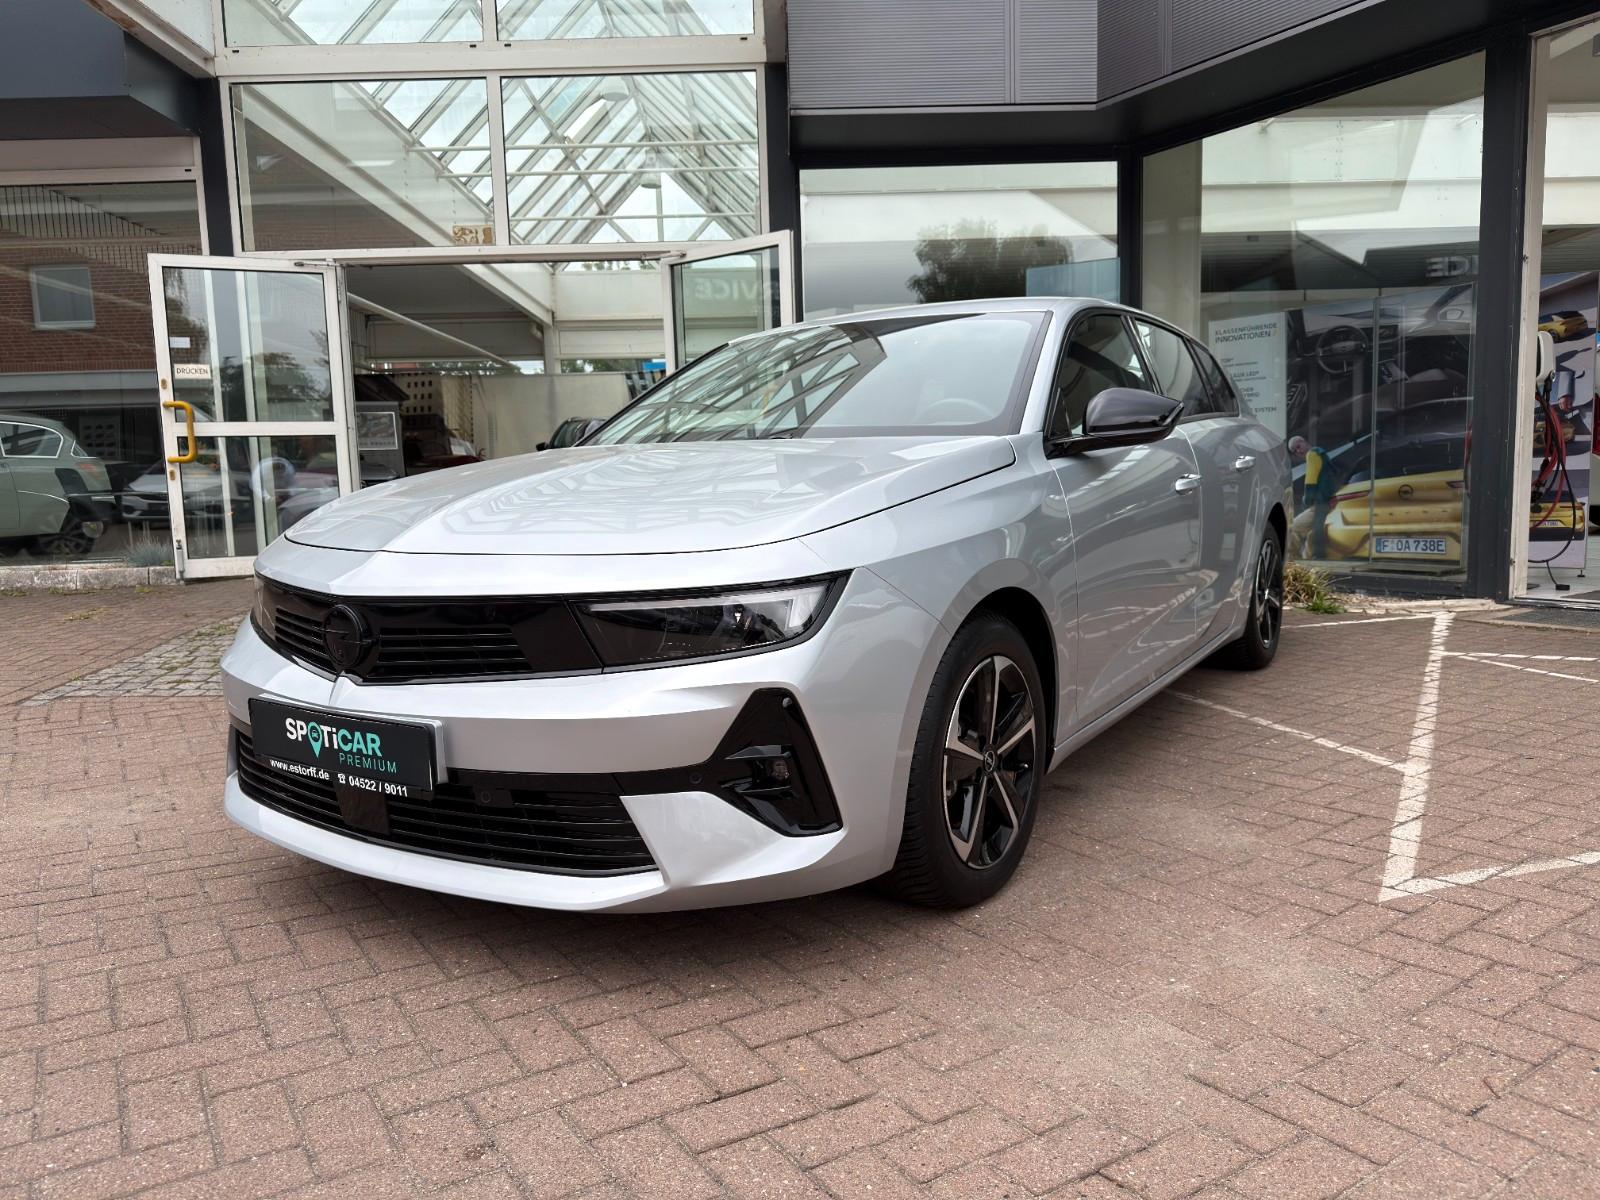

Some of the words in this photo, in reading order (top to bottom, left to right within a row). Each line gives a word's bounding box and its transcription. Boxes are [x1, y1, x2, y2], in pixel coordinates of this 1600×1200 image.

[1215, 330, 1272, 343] INNOVATIONEN
[176, 366, 209, 375] DRÜCKEN
[1382, 540, 1390, 551] F
[1396, 540, 1411, 552] OA
[1414, 540, 1445, 553] 738E
[339, 752, 398, 774] PREMIUM
[270, 758, 331, 781] www.estorff.de
[348, 775, 377, 793] 04522
[385, 784, 408, 798] 9011
